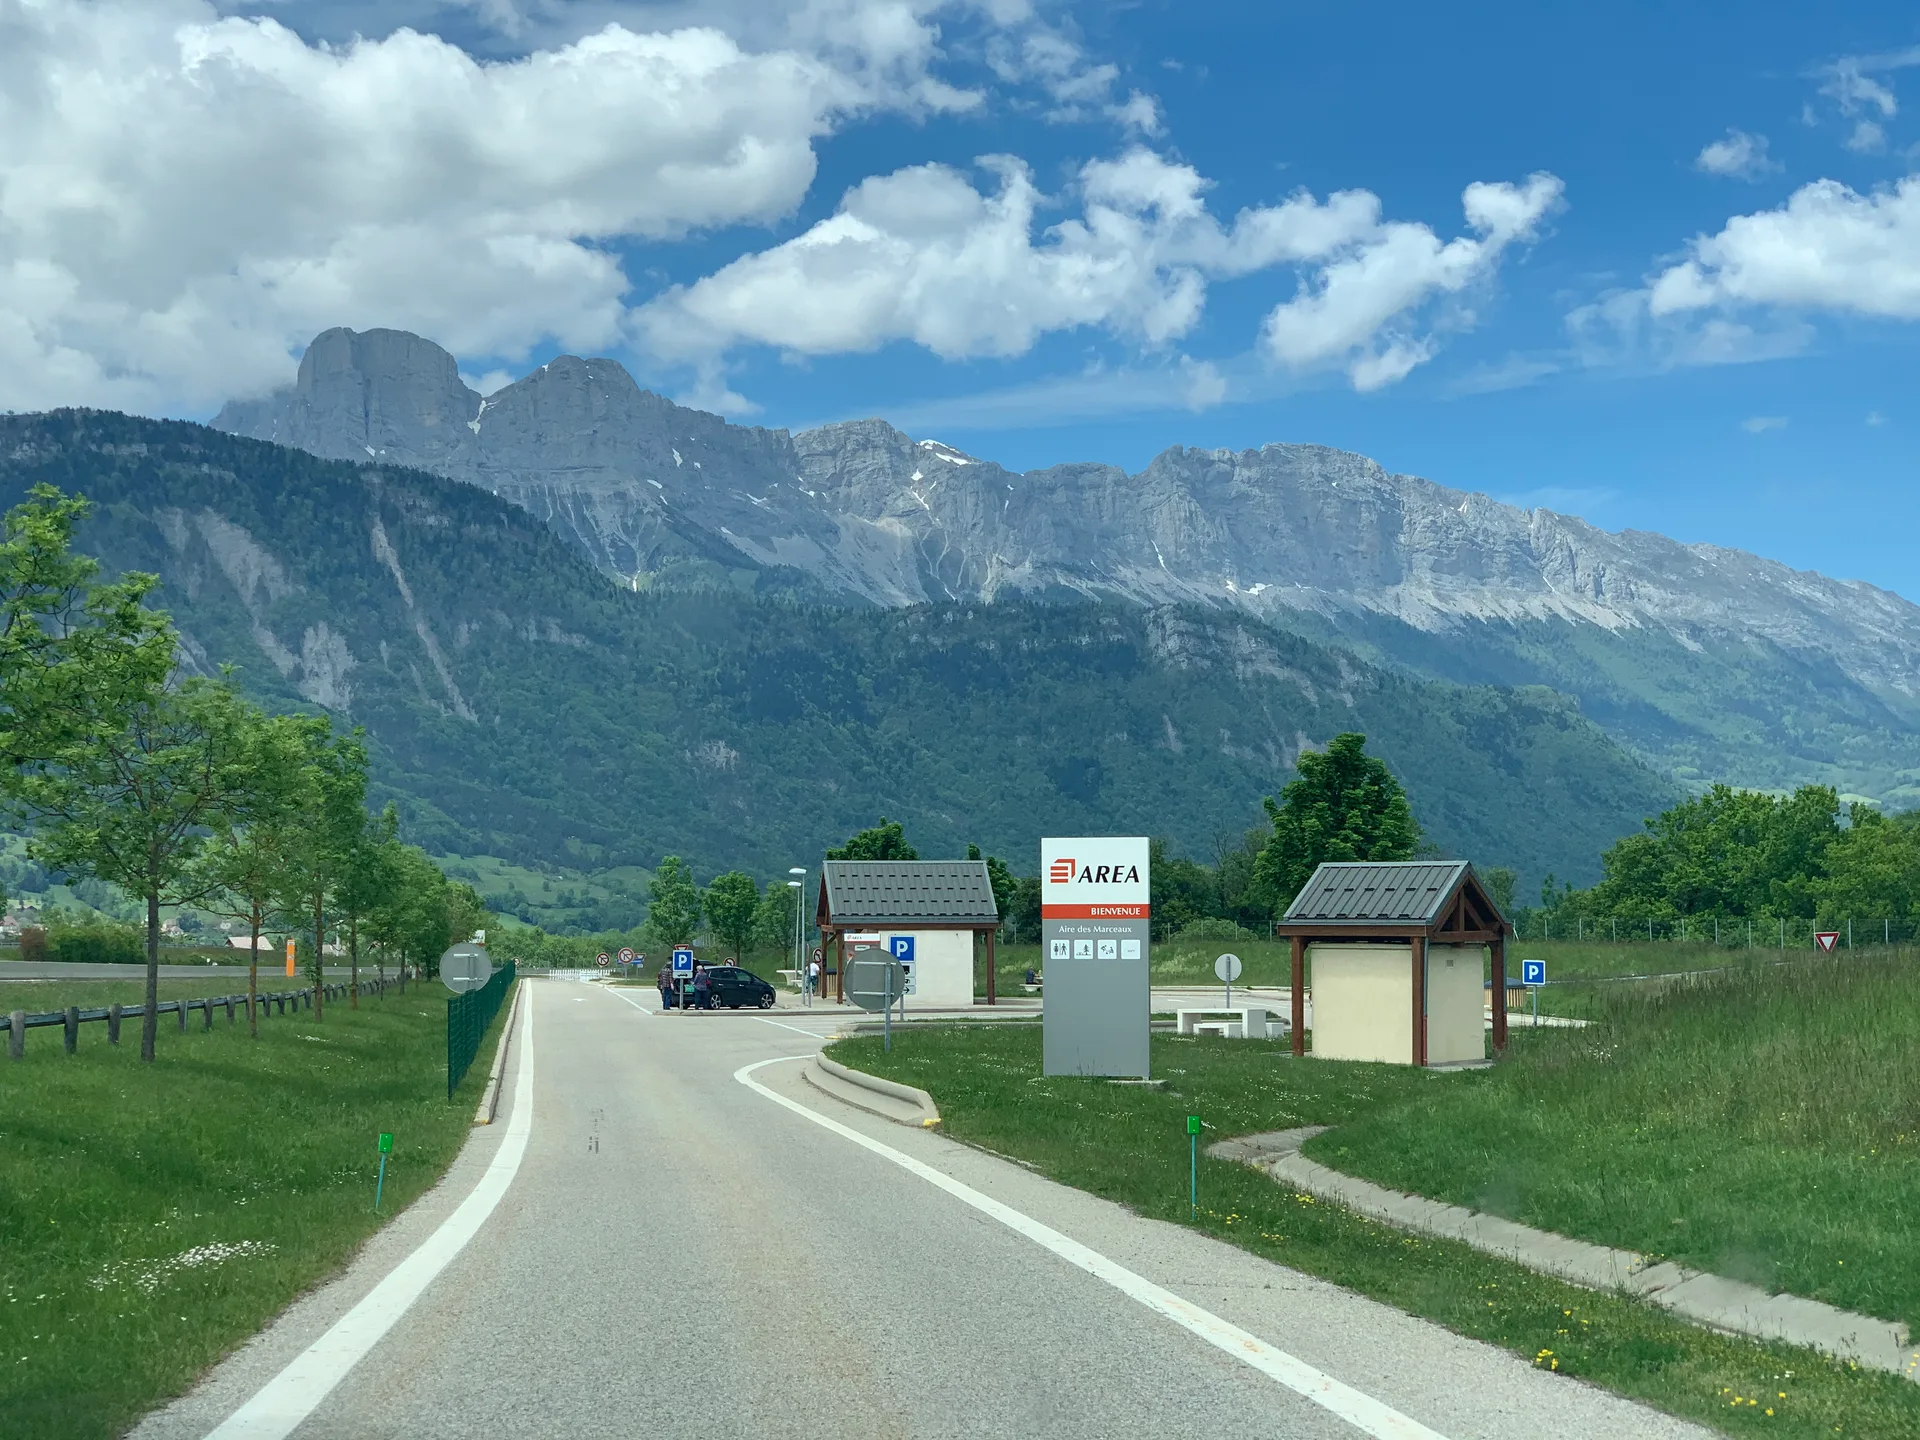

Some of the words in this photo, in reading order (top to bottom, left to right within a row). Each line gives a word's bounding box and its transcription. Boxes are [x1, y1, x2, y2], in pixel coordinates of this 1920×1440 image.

[1078, 865, 1140, 883] AREA
[1091, 907, 1141, 916] BIENVENUE
[1058, 925, 1076, 933] Aire
[1077, 925, 1092, 933] des
[1093, 925, 1132, 933] Marceaux
[896, 940, 908, 957] P
[679, 955, 687, 967] P
[1529, 965, 1539, 979] P
